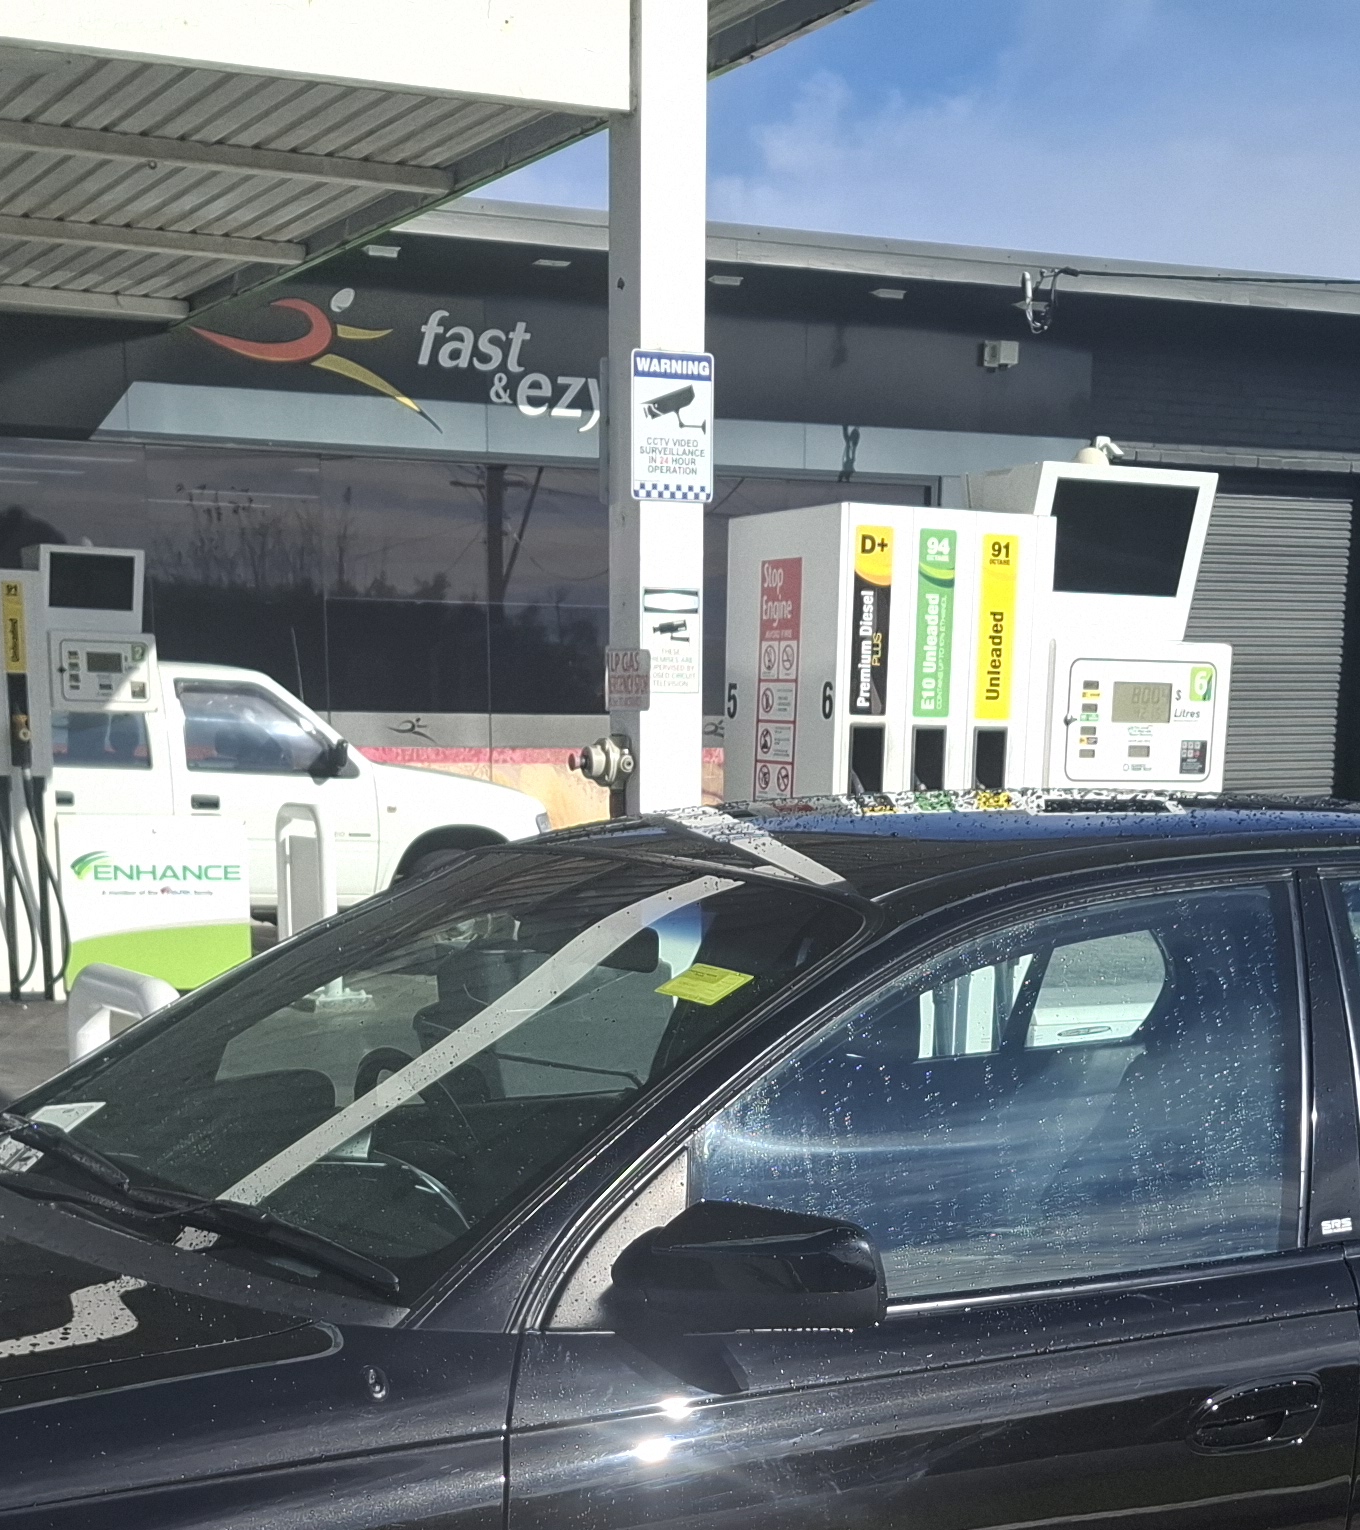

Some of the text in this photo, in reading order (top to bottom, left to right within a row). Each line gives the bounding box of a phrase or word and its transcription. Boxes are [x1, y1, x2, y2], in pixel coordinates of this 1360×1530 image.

[418, 309, 532, 373] fast
[635, 356, 710, 376] WARNING
[490, 372, 601, 433] & ezy
[640, 446, 705, 458] SURVEILLANCE
[646, 437, 699, 448] CCTV VIDEO
[647, 465, 698, 475] OPERATION
[648, 455, 696, 466] IN 24 HOUR
[860, 533, 889, 555] D+
[926, 536, 951, 555] 94
[990, 541, 1011, 559] 91
[763, 561, 784, 595] Stop
[762, 594, 793, 628] Engine
[856, 590, 874, 707] Premium Diesel
[871, 632, 882, 666] PLUS
[921, 593, 939, 710] E10 Unleaded
[985, 611, 1004, 701] Unleaded
[1194, 670, 1208, 697] 6
[727, 682, 738, 719] 5
[821, 681, 834, 719] 6
[1173, 708, 1201, 719] Litres
[93, 864, 242, 881] ENHANCE
[1321, 1217, 1353, 1230] SRS
